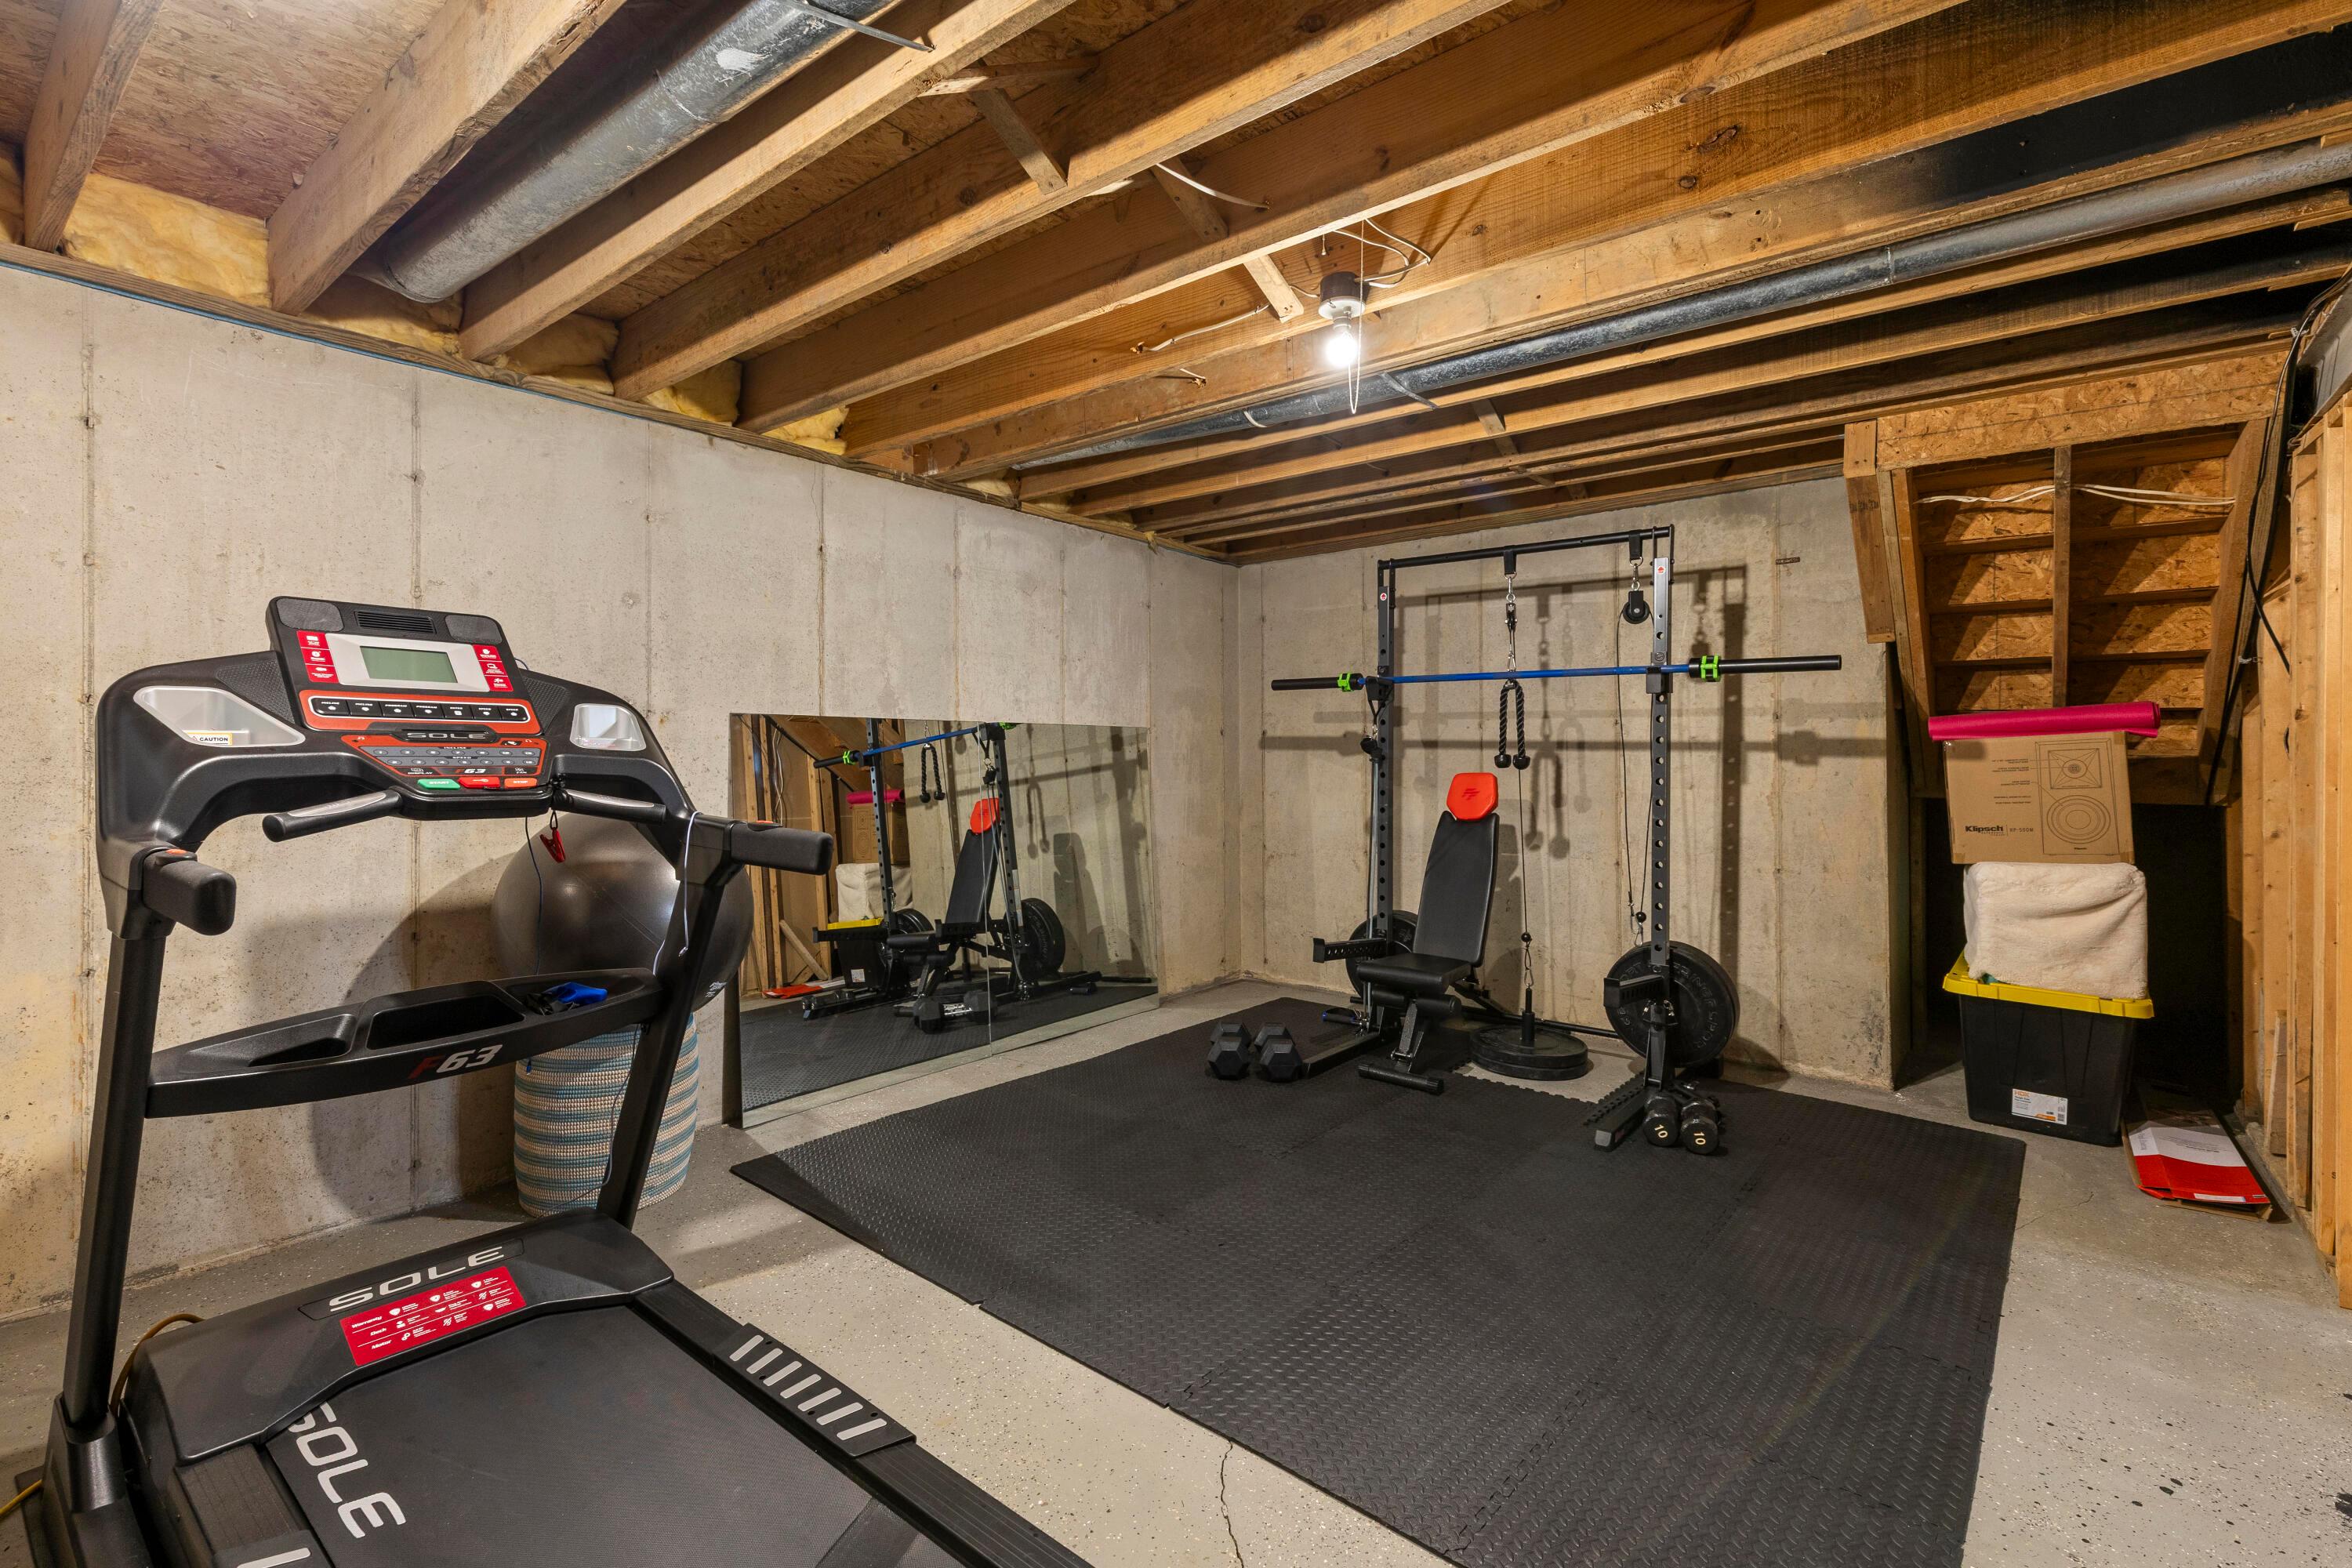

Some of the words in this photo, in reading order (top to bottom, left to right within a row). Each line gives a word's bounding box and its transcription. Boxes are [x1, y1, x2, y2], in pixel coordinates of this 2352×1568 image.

[408, 1044, 503, 1080] F63
[1654, 1124, 1668, 1138] 10
[1693, 1131, 1706, 1145] 10
[329, 1246, 504, 1312] SOLE
[352, 1316, 382, 1328] Warranty
[370, 1328, 387, 1336] Deck
[371, 1340, 392, 1349] Motor
